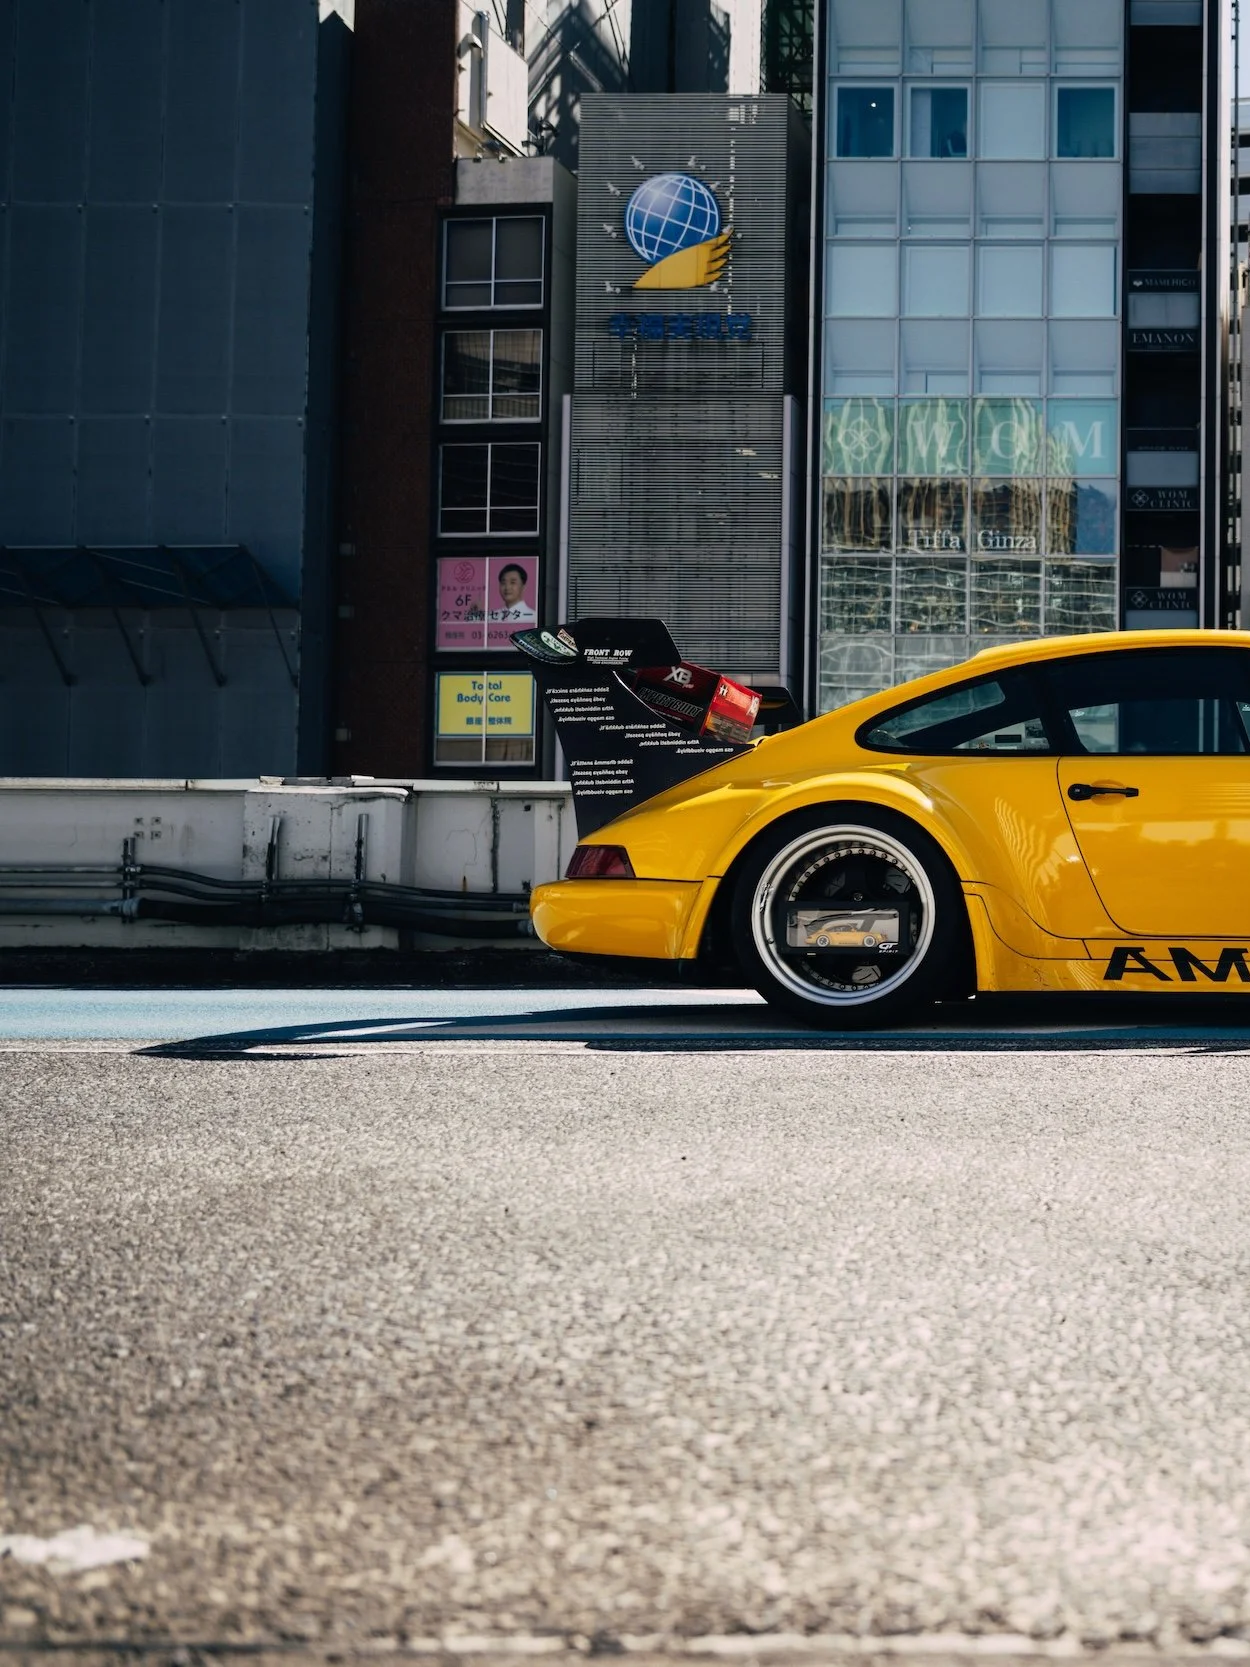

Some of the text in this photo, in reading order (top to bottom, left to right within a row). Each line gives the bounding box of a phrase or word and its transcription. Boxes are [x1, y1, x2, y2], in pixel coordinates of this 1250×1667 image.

[1133, 332, 1194, 343] EMANON
[911, 420, 1106, 460] WOM
[1157, 490, 1188, 499] WOM
[1151, 499, 1193, 508] CLINIC
[908, 529, 1037, 549] Tiffa Ginza
[455, 595, 472, 607] 6F
[1157, 592, 1187, 600] WOM
[1150, 601, 1191, 609] CLINIC
[472, 681, 502, 690] Total
[457, 693, 511, 704] Body Care
